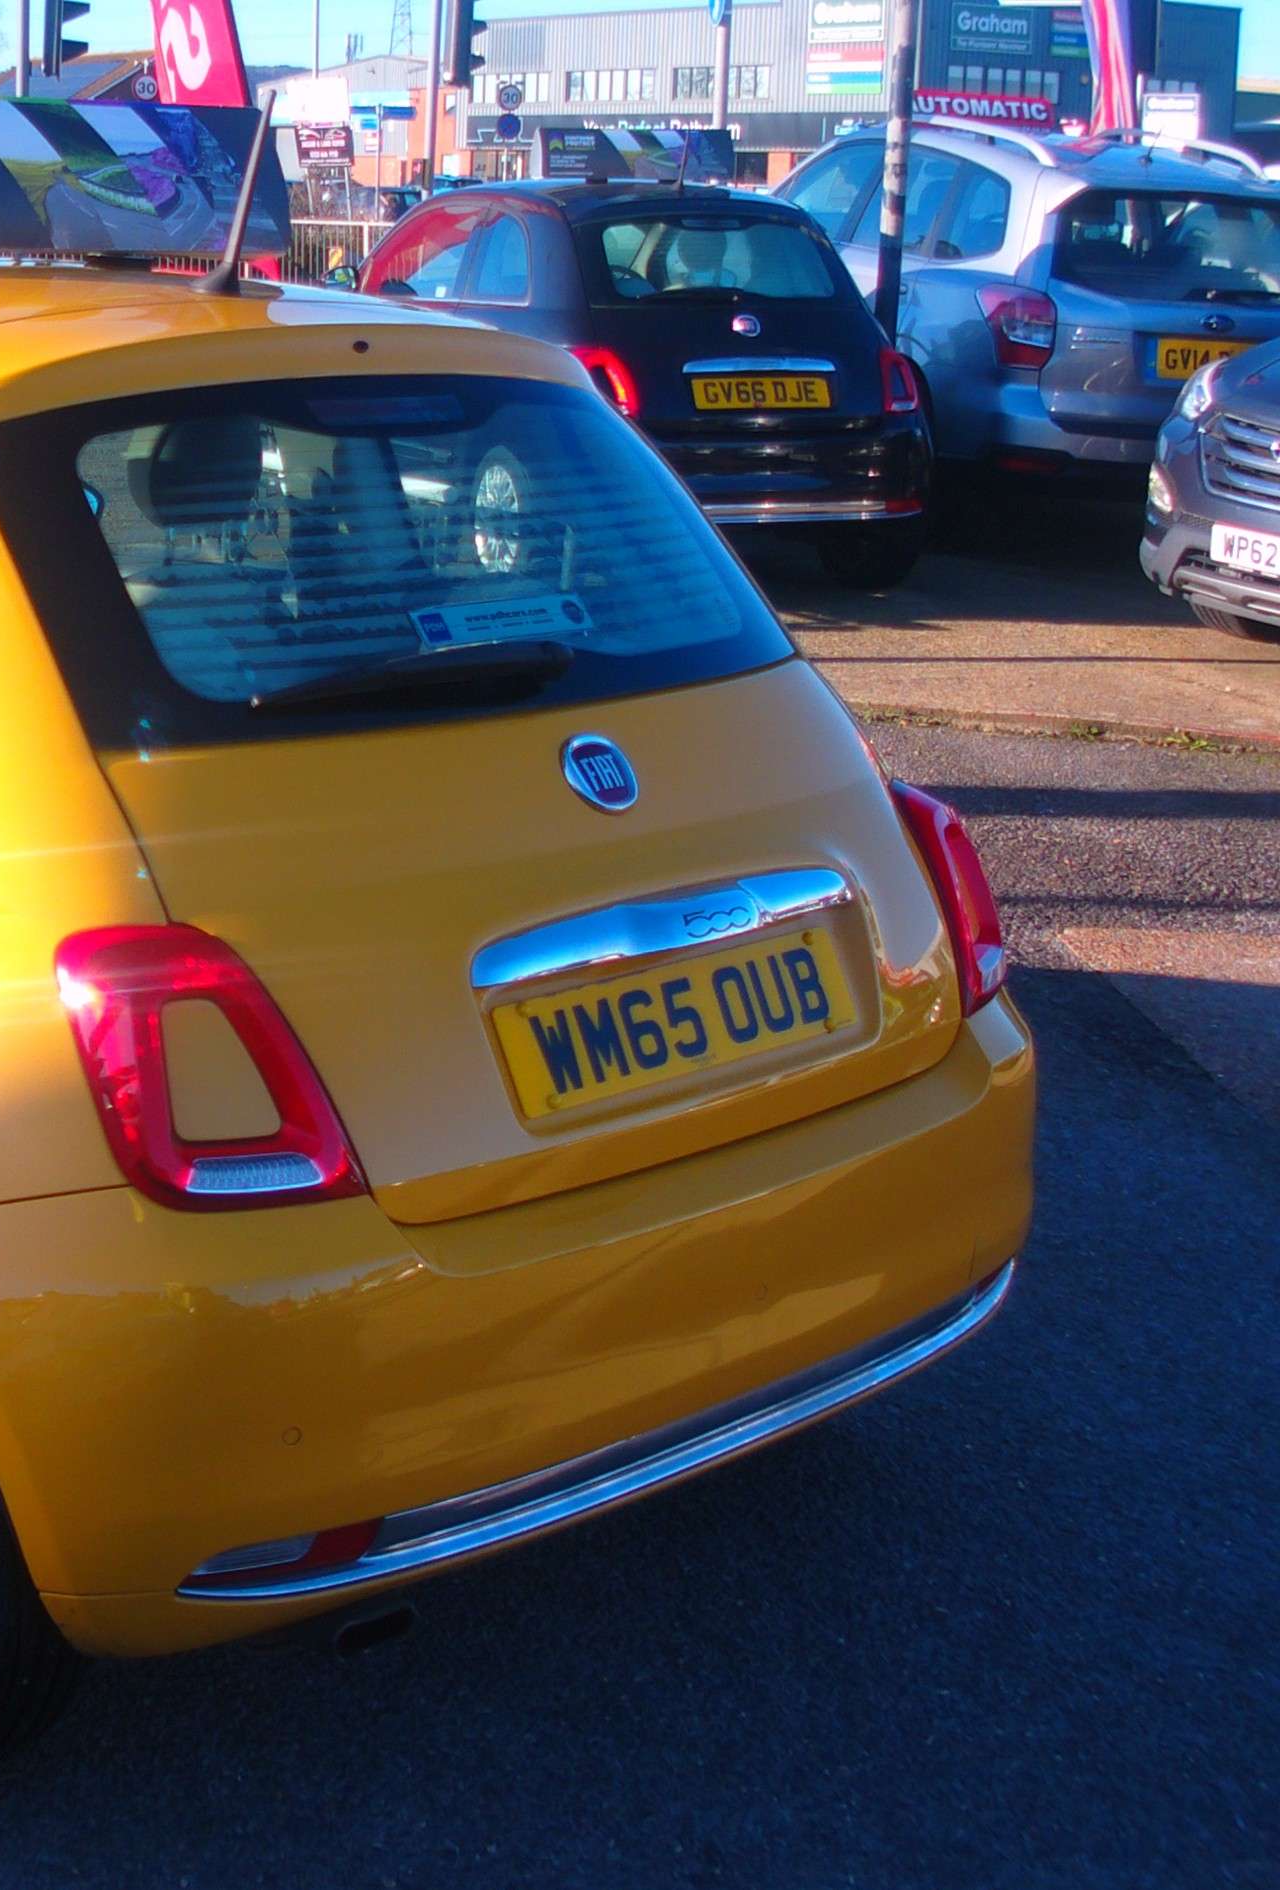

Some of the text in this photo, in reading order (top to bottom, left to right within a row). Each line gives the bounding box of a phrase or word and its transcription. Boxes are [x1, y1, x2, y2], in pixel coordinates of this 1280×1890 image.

[957, 11, 1028, 35] Graham
[137, 81, 156, 95] 30
[503, 92, 518, 104] 30
[1165, 348, 1210, 370] GV14
[703, 380, 818, 404] GV66 DJE
[1223, 532, 1278, 568] WP62
[579, 754, 626, 792] FIAT
[682, 905, 752, 938] 500
[528, 947, 831, 1095] WM65 OUB
